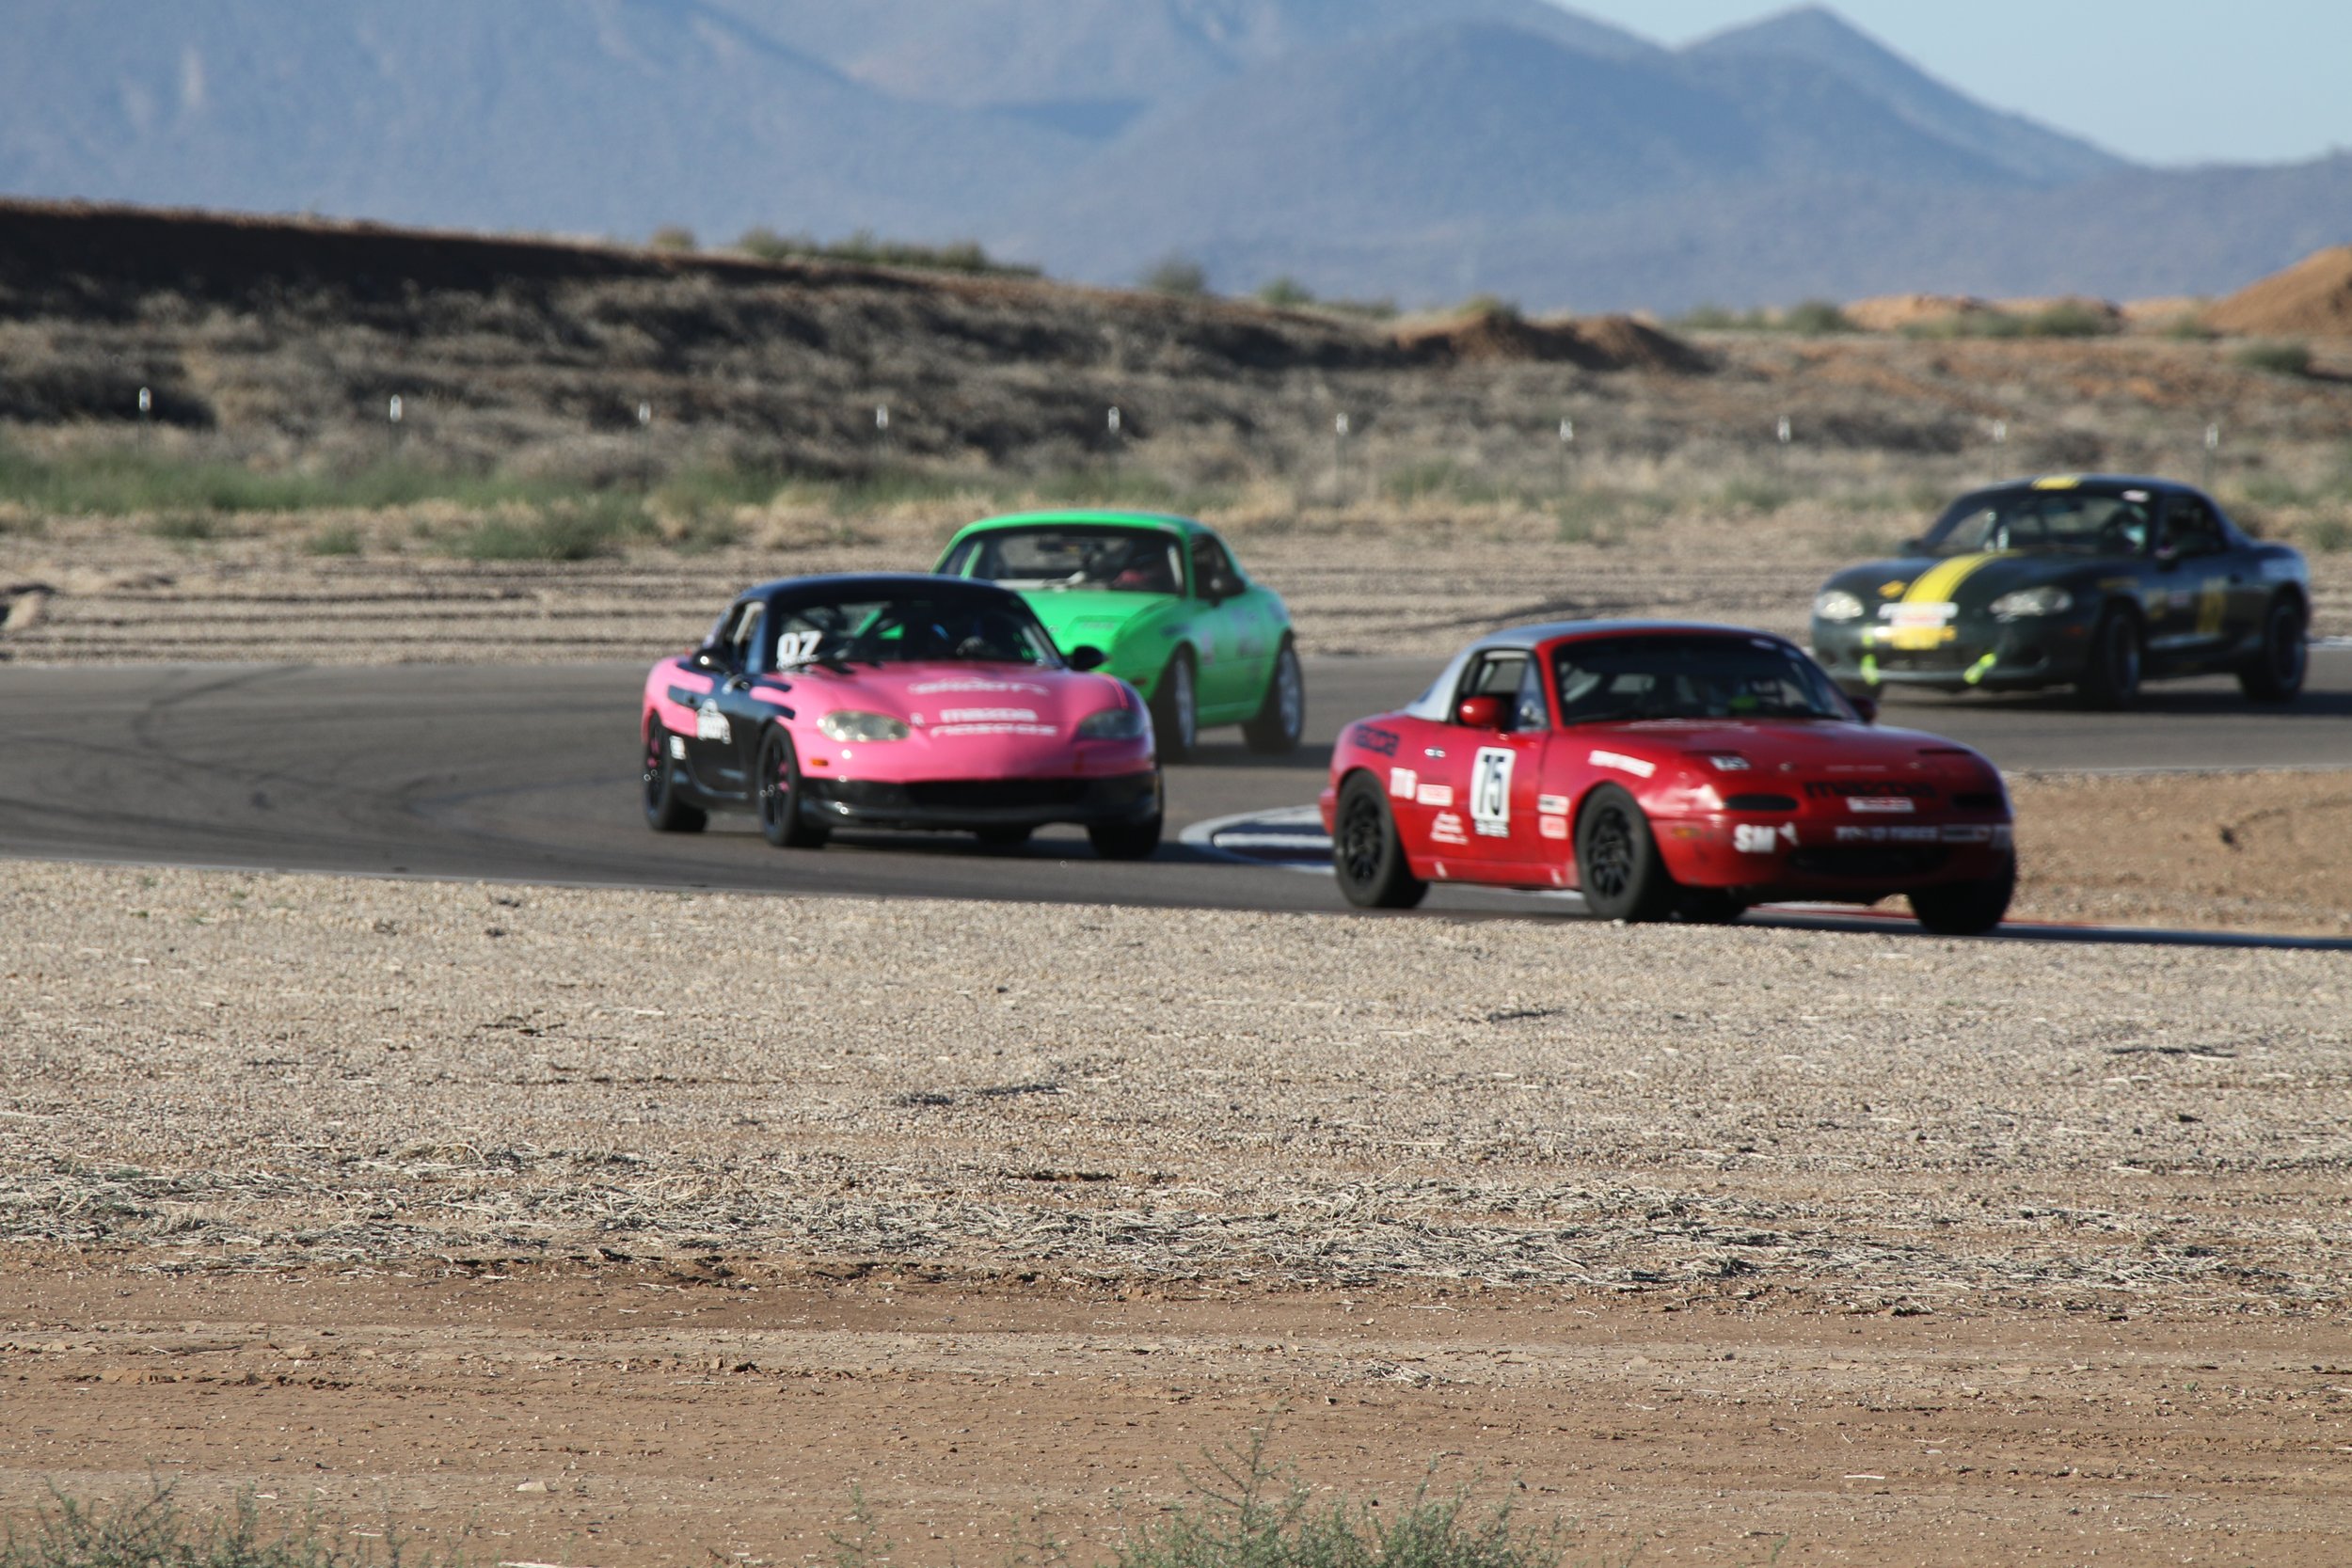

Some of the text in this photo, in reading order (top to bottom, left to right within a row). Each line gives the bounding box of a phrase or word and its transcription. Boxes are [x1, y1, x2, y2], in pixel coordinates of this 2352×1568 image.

[777, 630, 823, 658] 07
[1479, 754, 1506, 816] 75
[1733, 822, 1776, 852] SM
